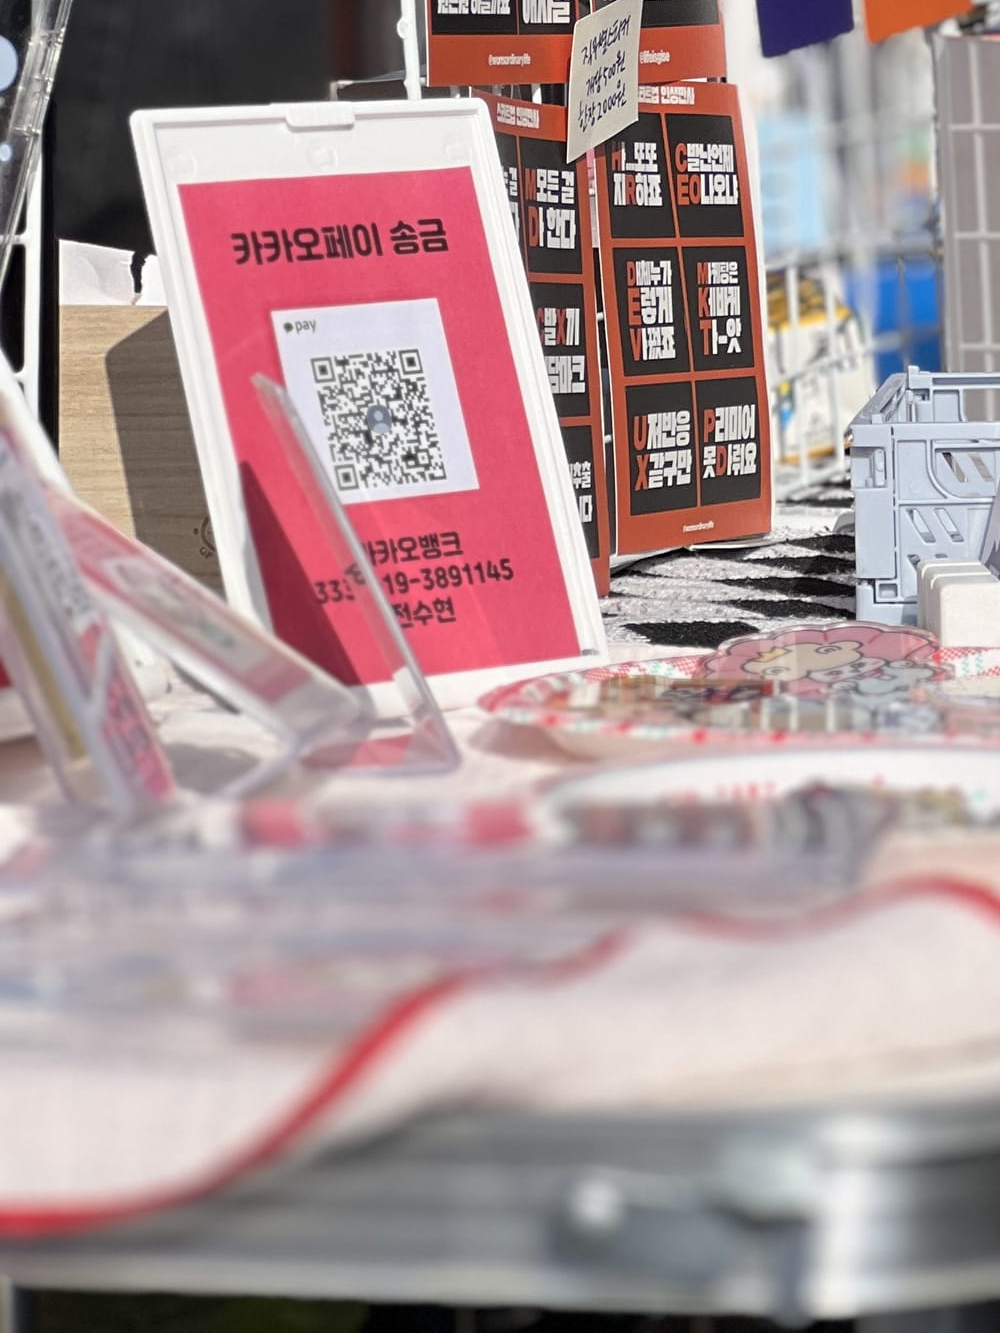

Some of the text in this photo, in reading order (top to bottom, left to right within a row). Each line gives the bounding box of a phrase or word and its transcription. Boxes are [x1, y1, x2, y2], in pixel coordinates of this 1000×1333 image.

[231, 218, 449, 265] 카카오페이 송금
[295, 318, 317, 333] pay
